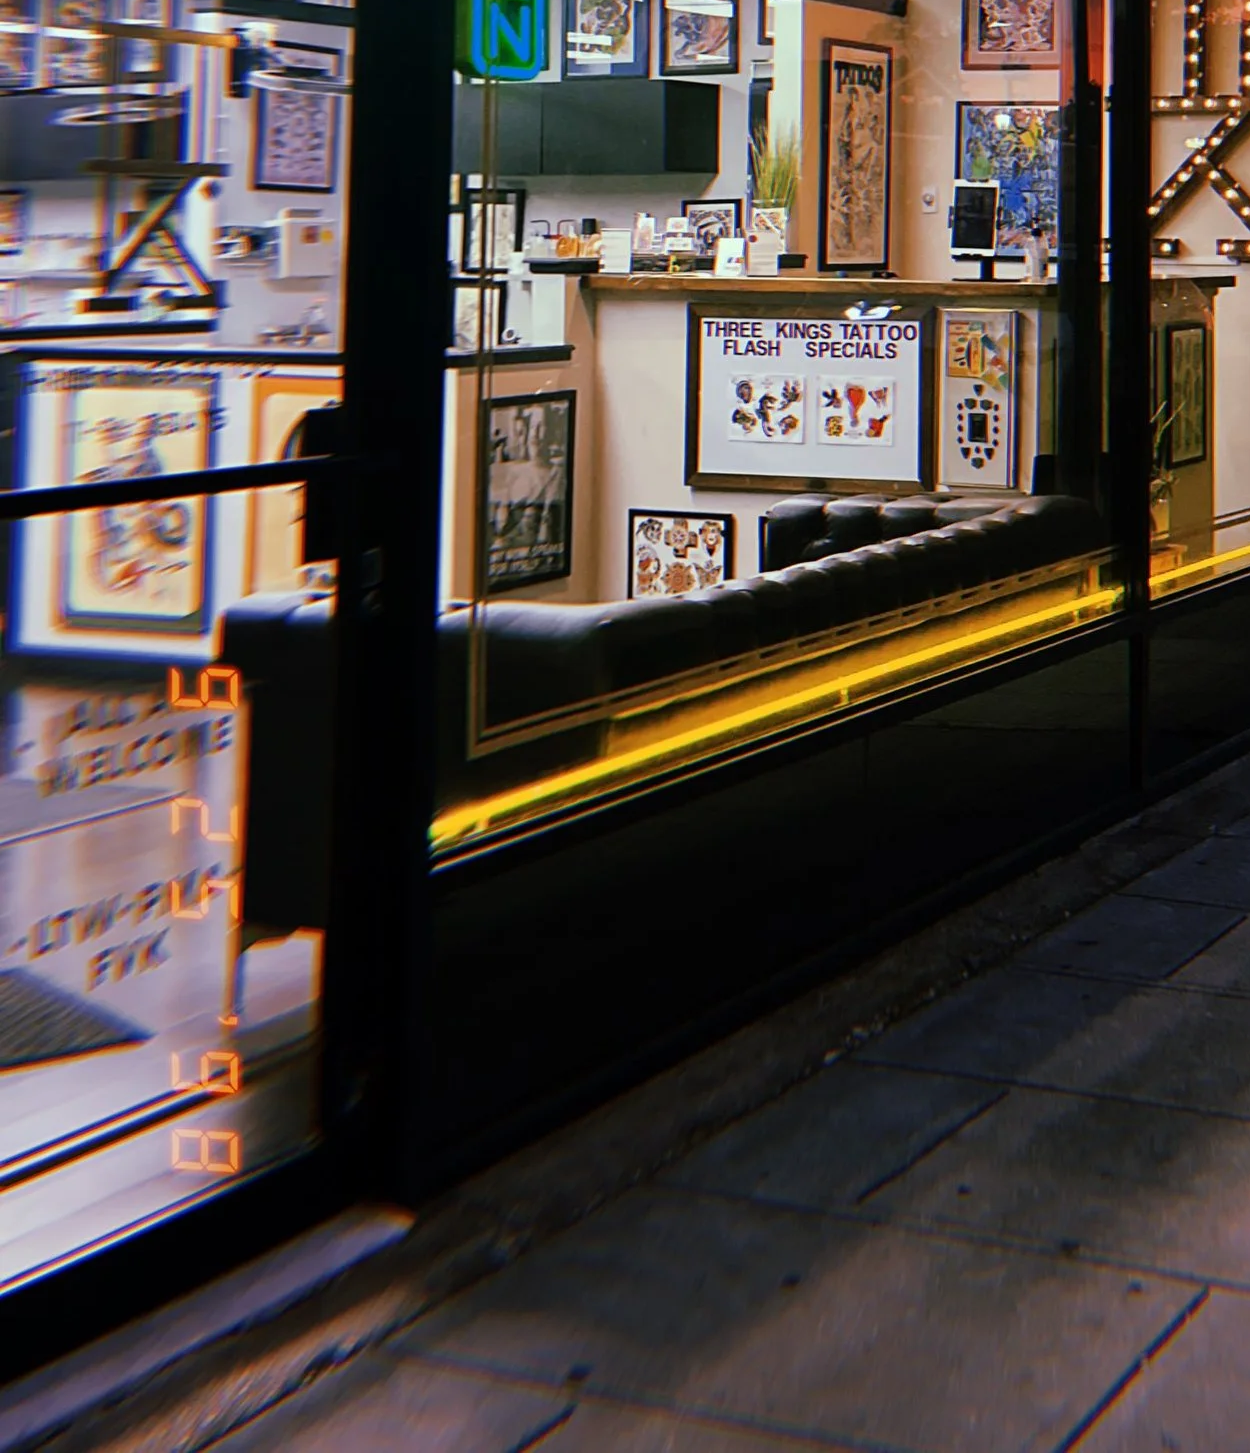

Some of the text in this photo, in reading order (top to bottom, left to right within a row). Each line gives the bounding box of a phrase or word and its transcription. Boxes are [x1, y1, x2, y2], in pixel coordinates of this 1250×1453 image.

[704, 321, 918, 342] THREE KINGS TATTOO
[723, 339, 898, 359] FLASH SPECIALS
